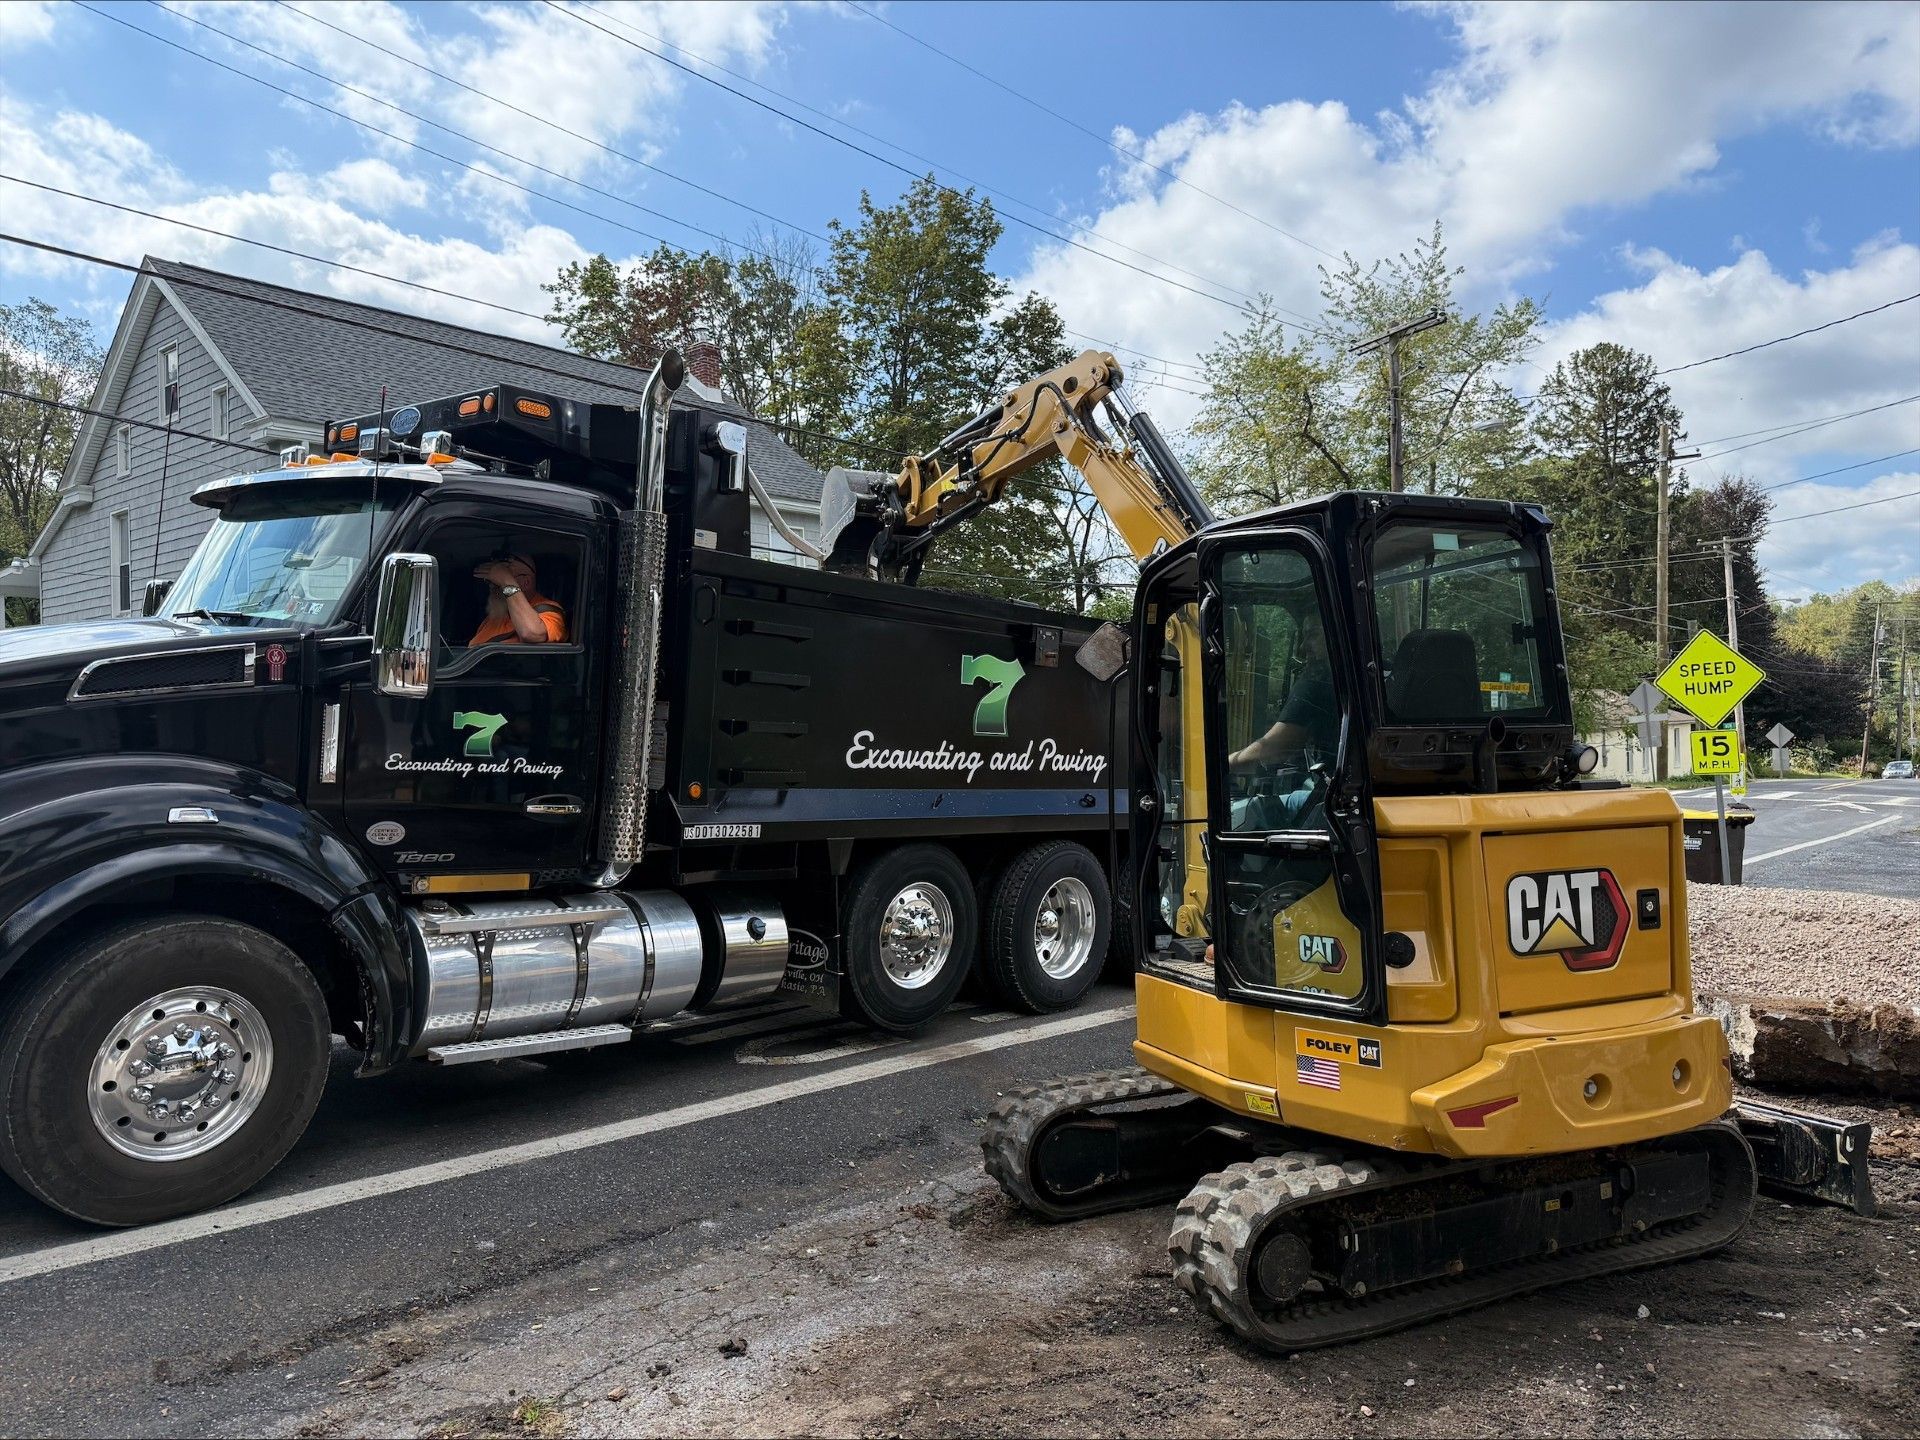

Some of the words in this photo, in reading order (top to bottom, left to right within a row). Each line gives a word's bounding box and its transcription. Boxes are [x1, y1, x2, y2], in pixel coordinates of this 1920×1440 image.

[1680, 661, 1736, 677] SPEED
[960, 654, 1026, 737] 7
[1685, 680, 1733, 695] HUMP
[453, 711, 508, 757] 7
[1699, 735, 1730, 756] 15
[384, 752, 474, 778] Excavating
[477, 758, 509, 773] and
[513, 757, 564, 779] Paving
[845, 729, 984, 783] Excavating
[989, 740, 1033, 771] and
[1038, 738, 1107, 783] Paving
[393, 851, 455, 863] T880
[1508, 871, 1599, 953] CAT
[1299, 935, 1334, 965] CAT
[1306, 1038, 1352, 1054] FOLEY
[1360, 1045, 1379, 1060] CAT
